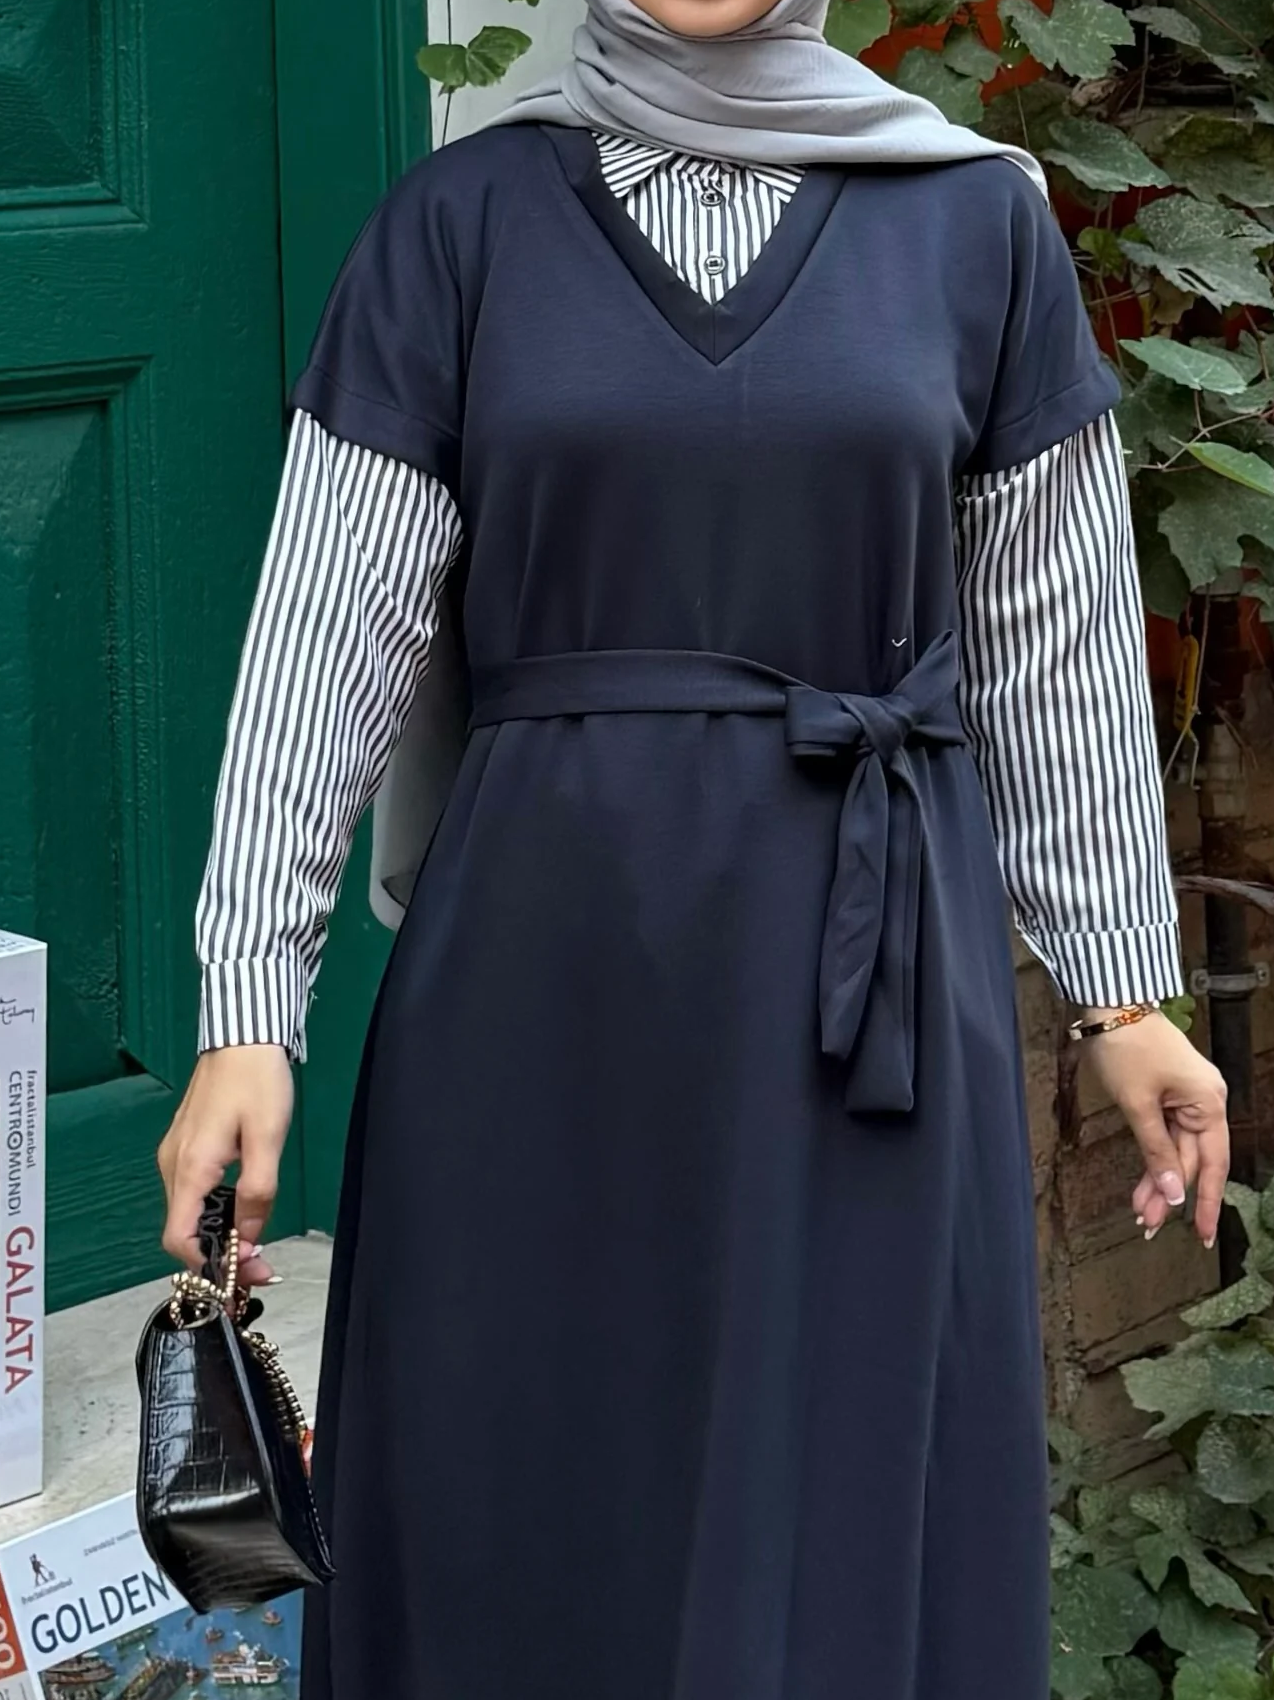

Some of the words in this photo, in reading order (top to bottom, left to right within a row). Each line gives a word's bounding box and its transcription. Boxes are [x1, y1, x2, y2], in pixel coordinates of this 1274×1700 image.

[6, 1070, 23, 1216] CENTROMUNDI
[25, 1070, 37, 1169] fractalistanbul
[4, 1226, 35, 1394] GALATA
[31, 1566, 171, 1654] GOLDEN
